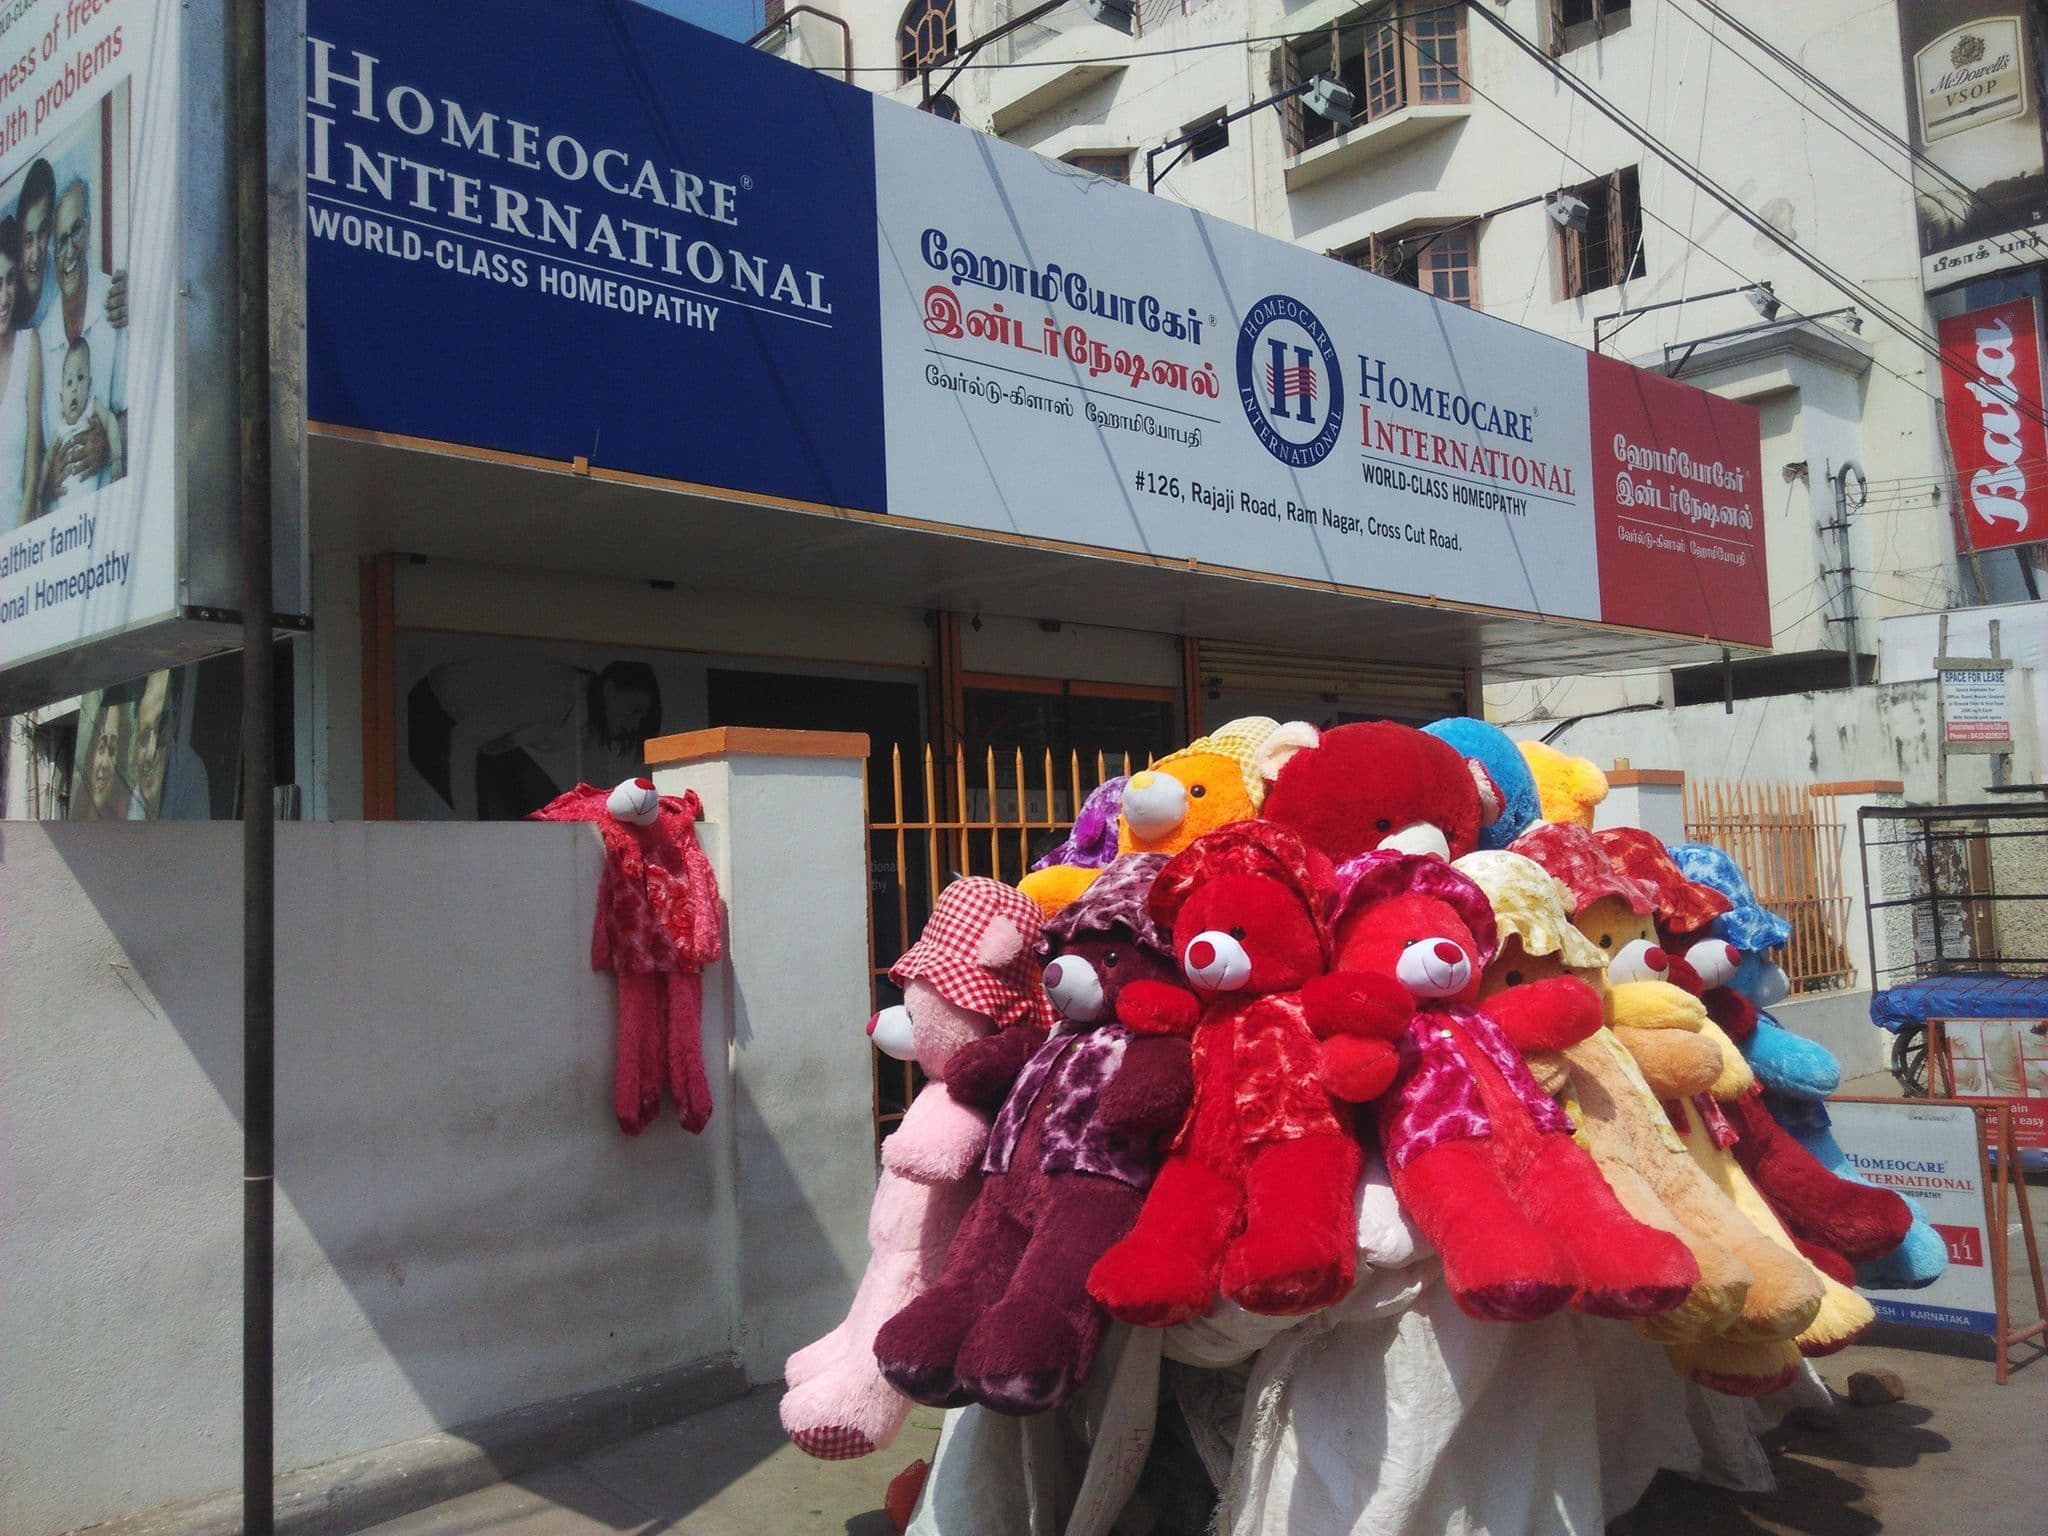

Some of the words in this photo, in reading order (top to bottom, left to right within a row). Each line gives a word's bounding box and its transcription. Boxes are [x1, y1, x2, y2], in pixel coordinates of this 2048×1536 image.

[43, 13, 60, 62] of
[35, 25, 122, 136] problems
[1946, 79, 1997, 107] VSOP
[307, 37, 738, 226] HOMEOCARE
[307, 112, 832, 314] INTERNATIONAL
[308, 205, 528, 288] WORLD-CLASS
[540, 265, 720, 332] HOMEOPATHY
[920, 228, 1203, 344] ஹோமியோகேர்
[923, 284, 1220, 399] இன்டர்நேஷனல்
[1244, 300, 1335, 361] HOMEOCARE
[1241, 387, 1342, 465] INTERNATIONAL
[1358, 355, 1534, 442] HOMEOCARE
[1965, 317, 2029, 533] Bata
[1360, 403, 1576, 497] INTERNATIONAL
[1135, 471, 1185, 502] #126,
[1191, 482, 1235, 514] Rajaji
[1240, 491, 1281, 522] Road,
[1286, 501, 1317, 525] Ram
[1322, 509, 1364, 537] Nagar,
[1367, 517, 1401, 541] Cross
[1404, 524, 1426, 546] Cut
[1429, 529, 1463, 551] Road.
[1362, 463, 1448, 500] WORLD-CLASS
[1453, 484, 1527, 517] HOMEOPATHY
[50, 513, 96, 557] family
[35, 550, 129, 611] Homeopathy
[1945, 671, 1966, 682] SPACE
[1968, 671, 1981, 682] FOR
[1983, 671, 2004, 682] LEASE
[2010, 1103, 2028, 1113] ain
[2020, 1117, 2044, 1127] easy
[1846, 1153, 1945, 1173] HOMEOCARE
[1860, 1173, 1974, 1191] TERNATIONAL
[1898, 1189, 1941, 1199] OMEOPATHY
[1910, 1310, 1970, 1326] KARNATAKA
